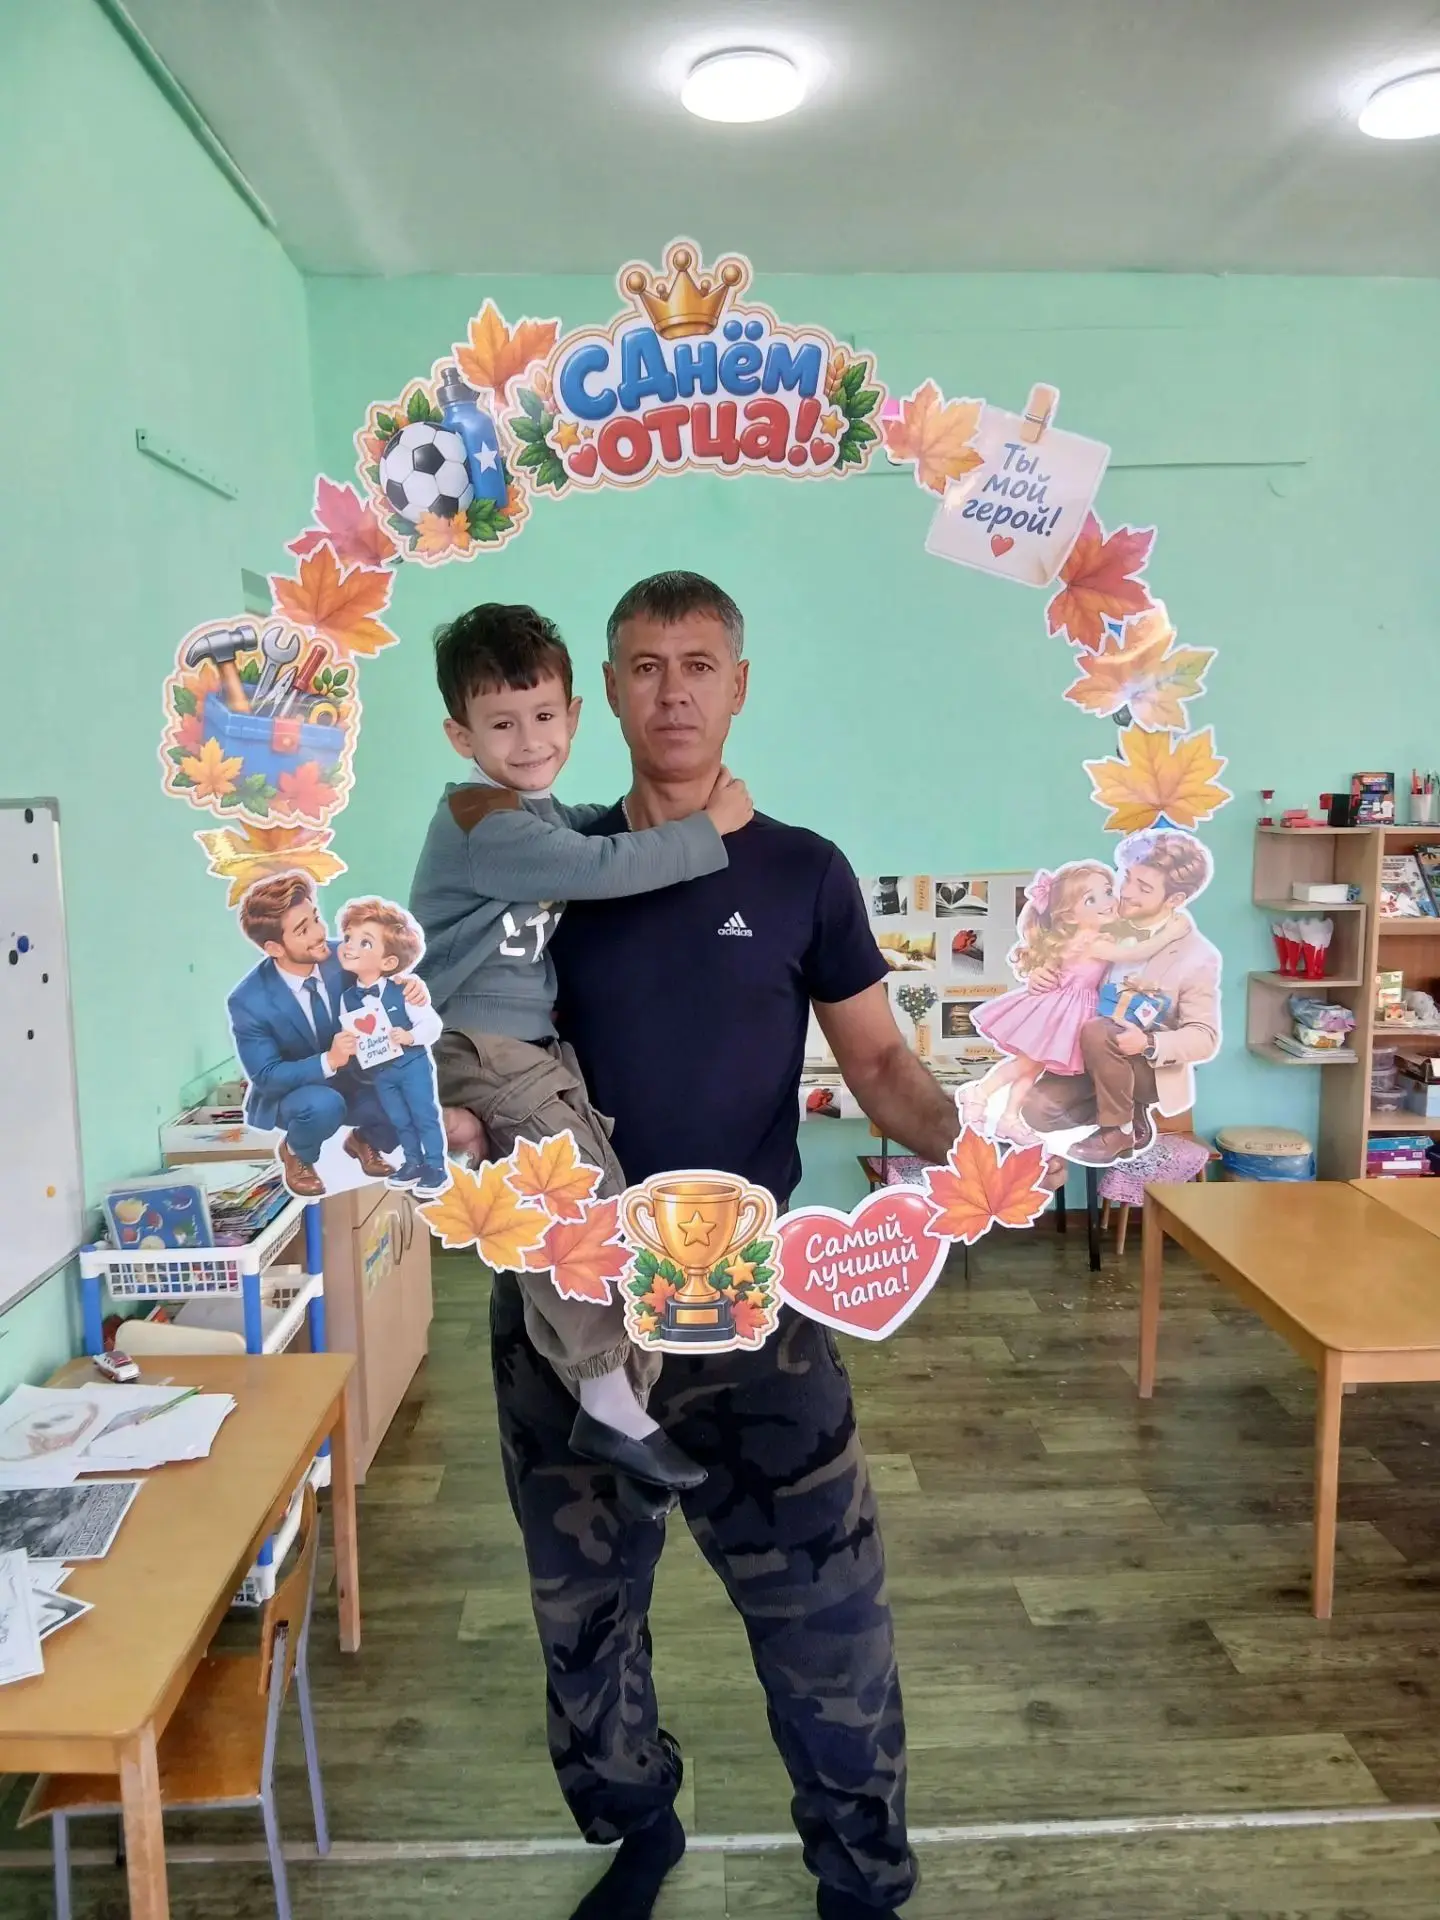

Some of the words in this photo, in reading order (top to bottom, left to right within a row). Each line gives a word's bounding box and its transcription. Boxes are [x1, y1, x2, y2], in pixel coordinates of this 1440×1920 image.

[1003, 443, 1039, 474] Ты
[982, 473, 1051, 504] мой
[962, 499, 1062, 537] герой!
[718, 927, 752, 937] adidas
[805, 1213, 904, 1264] Самый
[804, 1236, 919, 1292] лучший
[833, 1267, 910, 1311] папа!
